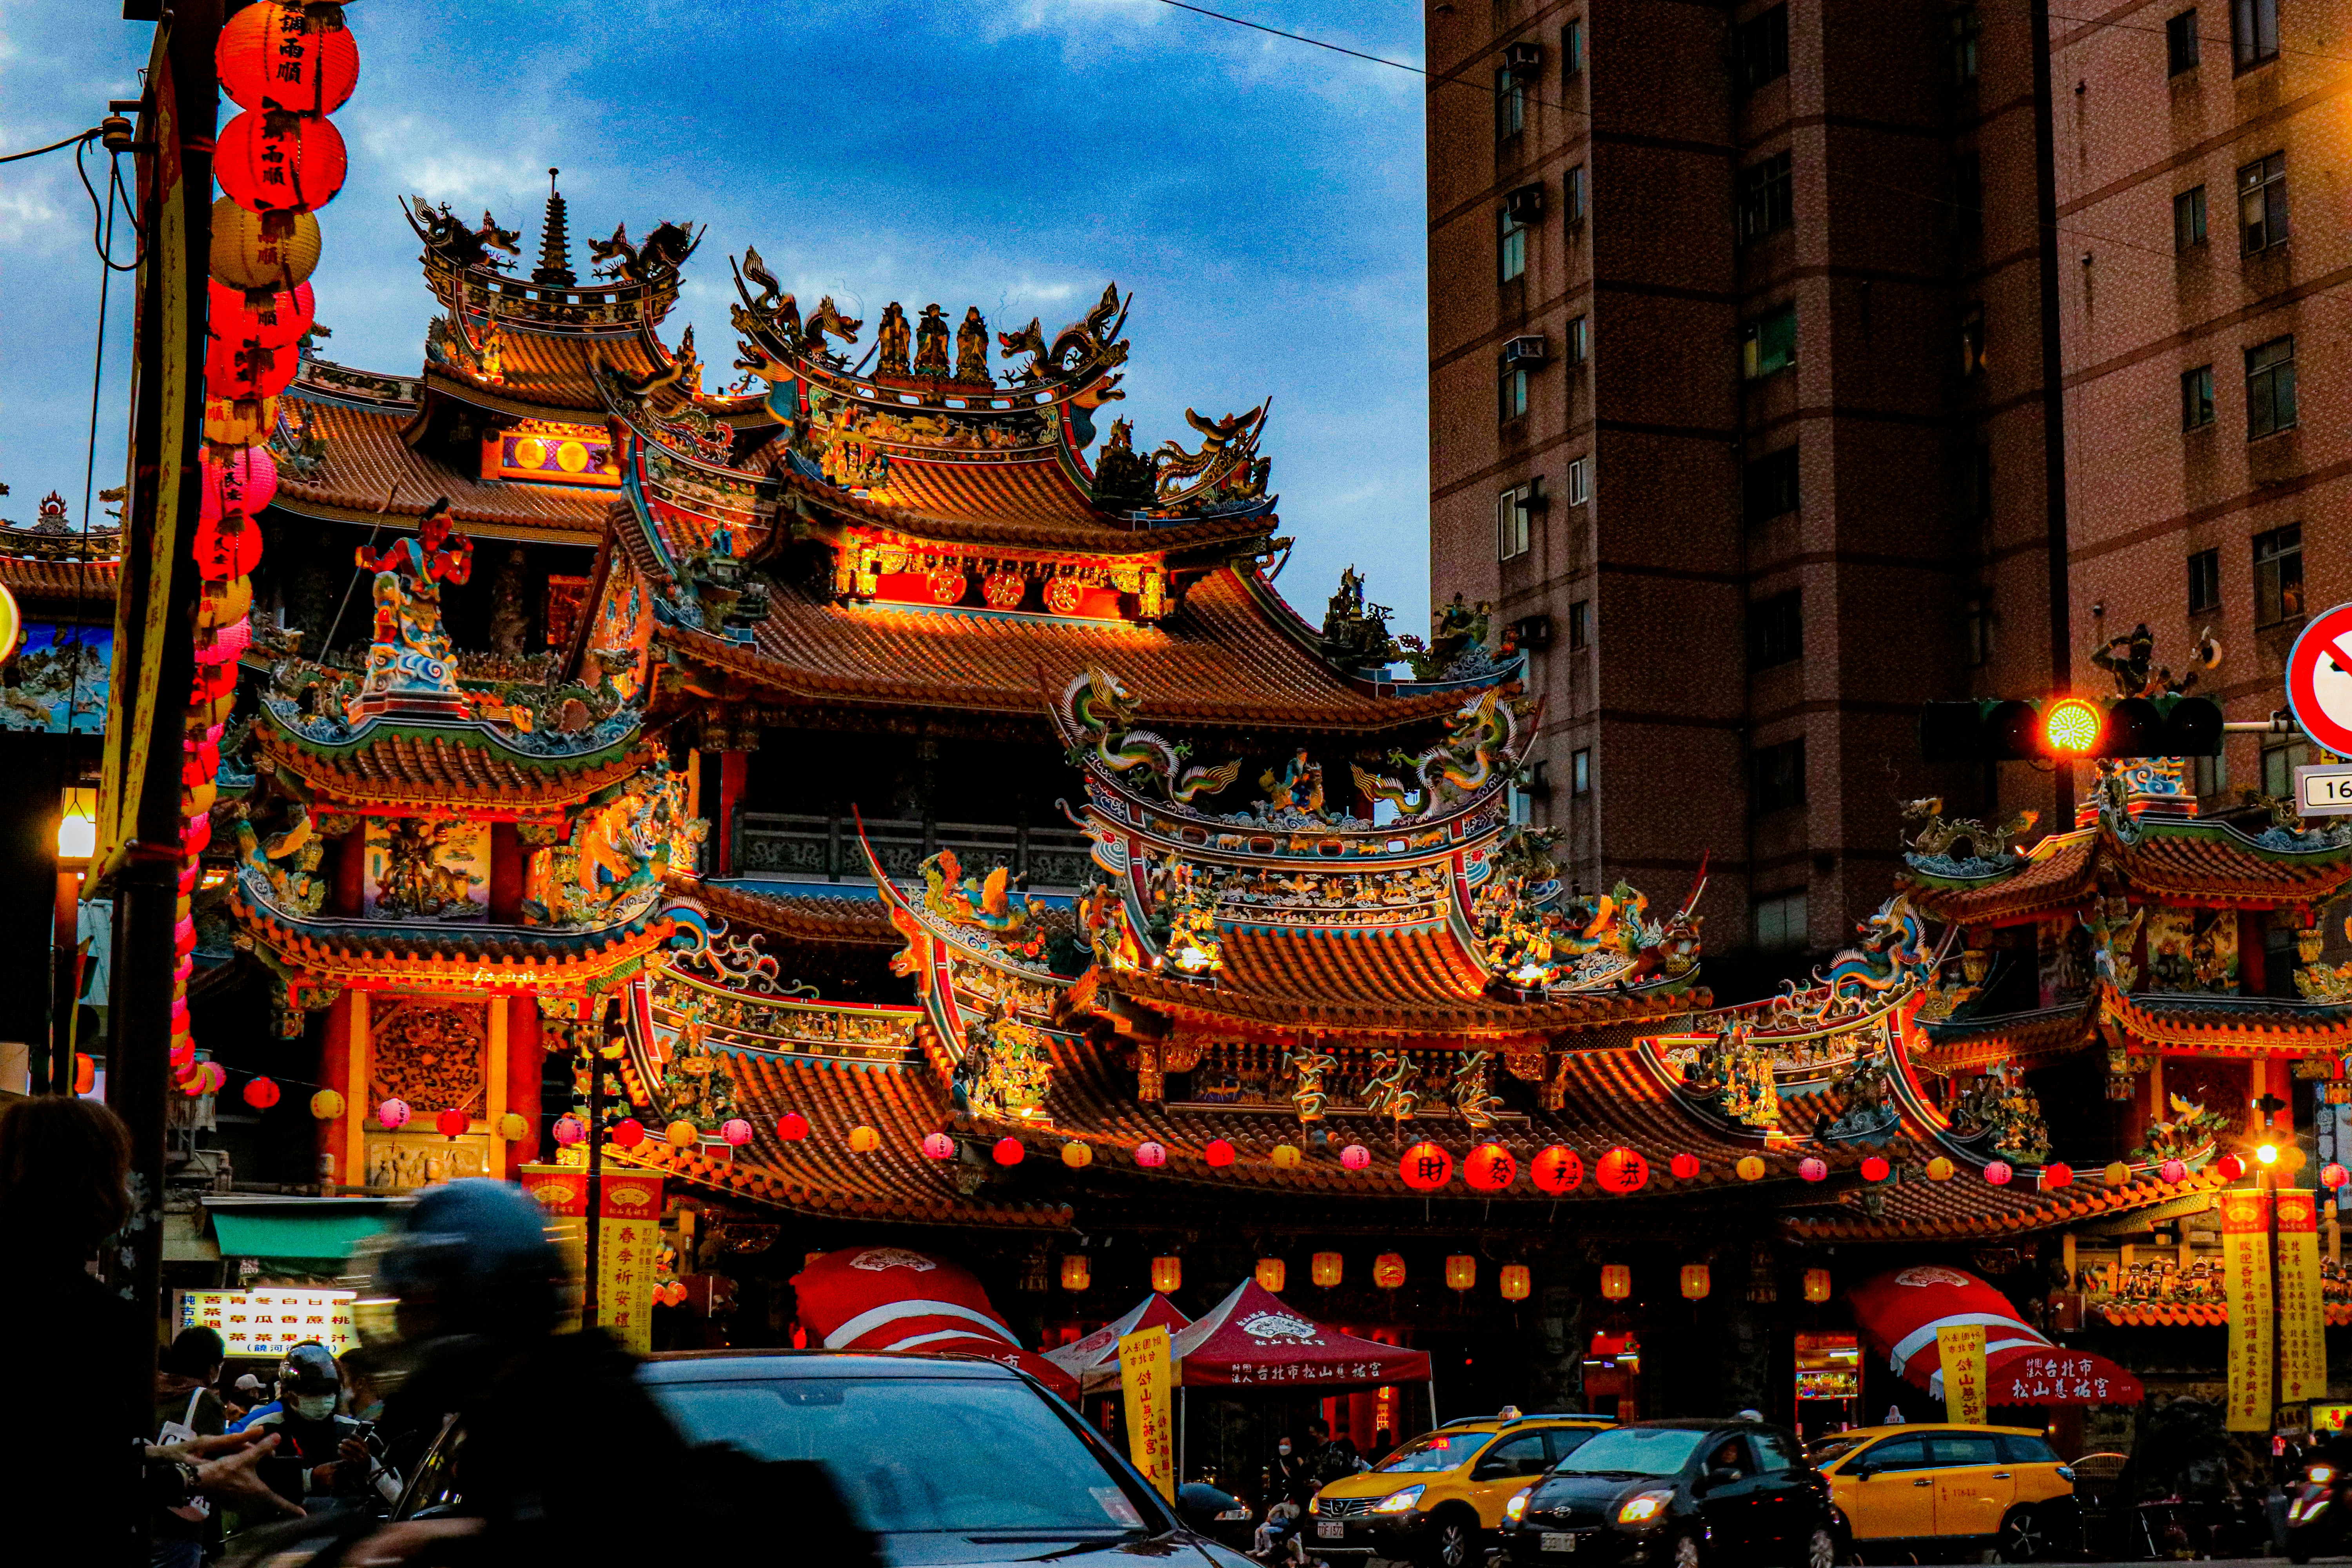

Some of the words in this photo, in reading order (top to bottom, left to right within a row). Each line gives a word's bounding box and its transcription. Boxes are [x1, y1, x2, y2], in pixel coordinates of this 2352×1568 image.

[229, 1296, 247, 1341] 青草茶
[255, 1296, 273, 1342] 冬瓜茶
[2044, 1358, 2093, 1377] 台北市
[2012, 1377, 2109, 1399] 松山慈祐宮
